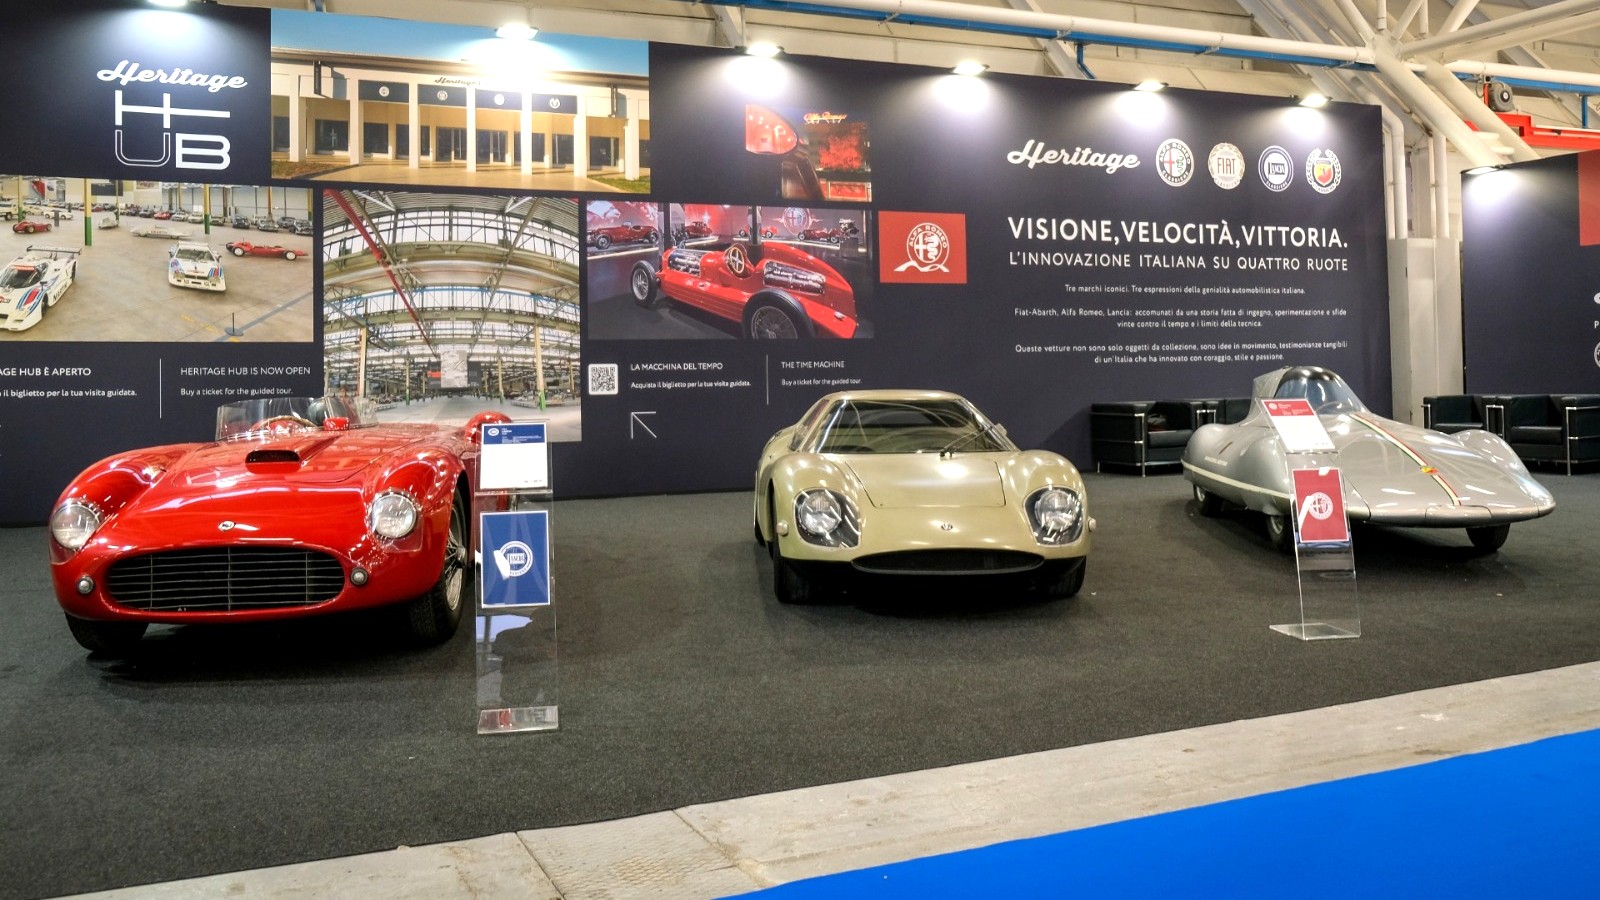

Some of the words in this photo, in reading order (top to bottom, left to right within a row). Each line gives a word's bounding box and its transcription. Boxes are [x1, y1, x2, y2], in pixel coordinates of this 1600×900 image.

[97, 60, 248, 93] Heritage
[1007, 139, 1141, 174] Heritage
[1172, 142, 1191, 165] ROMEO
[1217, 157, 1236, 175] FIAT
[908, 227, 923, 247] ALFA
[925, 225, 948, 249] ROMEO
[1010, 252, 1131, 267] L'INNOVAZIONE
[1139, 254, 1206, 269] ITALIANA
[1213, 256, 1230, 269] SU
[1237, 257, 1300, 271] QUATTRO
[1307, 258, 1348, 271] RUOTE
[1065, 284, 1076, 292] Tre
[1078, 285, 1102, 293] marchi
[1104, 285, 1129, 293] iconici.
[1131, 285, 1143, 293] Tre
[1144, 286, 1182, 294] espressioni
[1184, 286, 1201, 294] della
[1202, 286, 1231, 296] genialità
[1231, 286, 1280, 294] automobilistica
[1281, 286, 1306, 294] italiana.
[1014, 308, 1059, 316] Fiat-Abarth,
[1061, 308, 1076, 316] Alfa
[1079, 308, 1105, 317] Romeo,
[1221, 308, 1236, 316] fatta
[1246, 310, 1273, 318] ingegno,
[1274, 309, 1325, 318] sperimentazione
[1332, 308, 1347, 316] sfide
[1168, 321, 1189, 329] tempo
[1201, 320, 1219, 328] limiti
[1220, 320, 1237, 328] della
[1238, 320, 1263, 328] tecnica.
[1015, 344, 1042, 353] Queste
[1108, 344, 1124, 352] solo
[1125, 344, 1150, 353] oggetti
[1151, 343, 1160, 351] da
[1161, 343, 1199, 351] collezione,
[1217, 342, 1232, 350] idee
[1233, 342, 1240, 350] in
[1241, 342, 1278, 350] movimento,
[1279, 341, 1322, 349] testimonianze
[1323, 341, 1348, 350] tangibili
[1094, 356, 1102, 364] di
[1103, 355, 1133, 363] un'Italia
[1134, 355, 1147, 363] che
[1148, 355, 1158, 363] ha
[1159, 355, 1189, 363] innovato
[1203, 354, 1233, 363] coraggio,
[1234, 353, 1249, 361] stile
[1256, 353, 1284, 362] passione.
[642, 363, 683, 371] MACCHINA
[683, 362, 697, 371] DEL
[698, 362, 723, 370] TEMPO
[781, 361, 795, 369] THE
[796, 361, 812, 369] TIME
[813, 360, 845, 369] MACHINE
[19, 367, 42, 376] HUB
[44, 366, 50, 376] È
[52, 367, 92, 376] APERTO
[180, 367, 226, 376] HERITAGE
[228, 367, 249, 376] HUB
[250, 367, 259, 375] IS
[260, 367, 284, 375] NOW
[285, 366, 311, 375] OPEN
[11, 389, 45, 399] biglietto
[61, 389, 69, 397] la
[84, 389, 106, 397] visita
[107, 388, 138, 398] guidata.
[180, 388, 195, 397] Buy
[202, 388, 223, 396] ticket
[225, 387, 236, 395] for
[237, 387, 249, 395] the
[250, 387, 275, 396] guided
